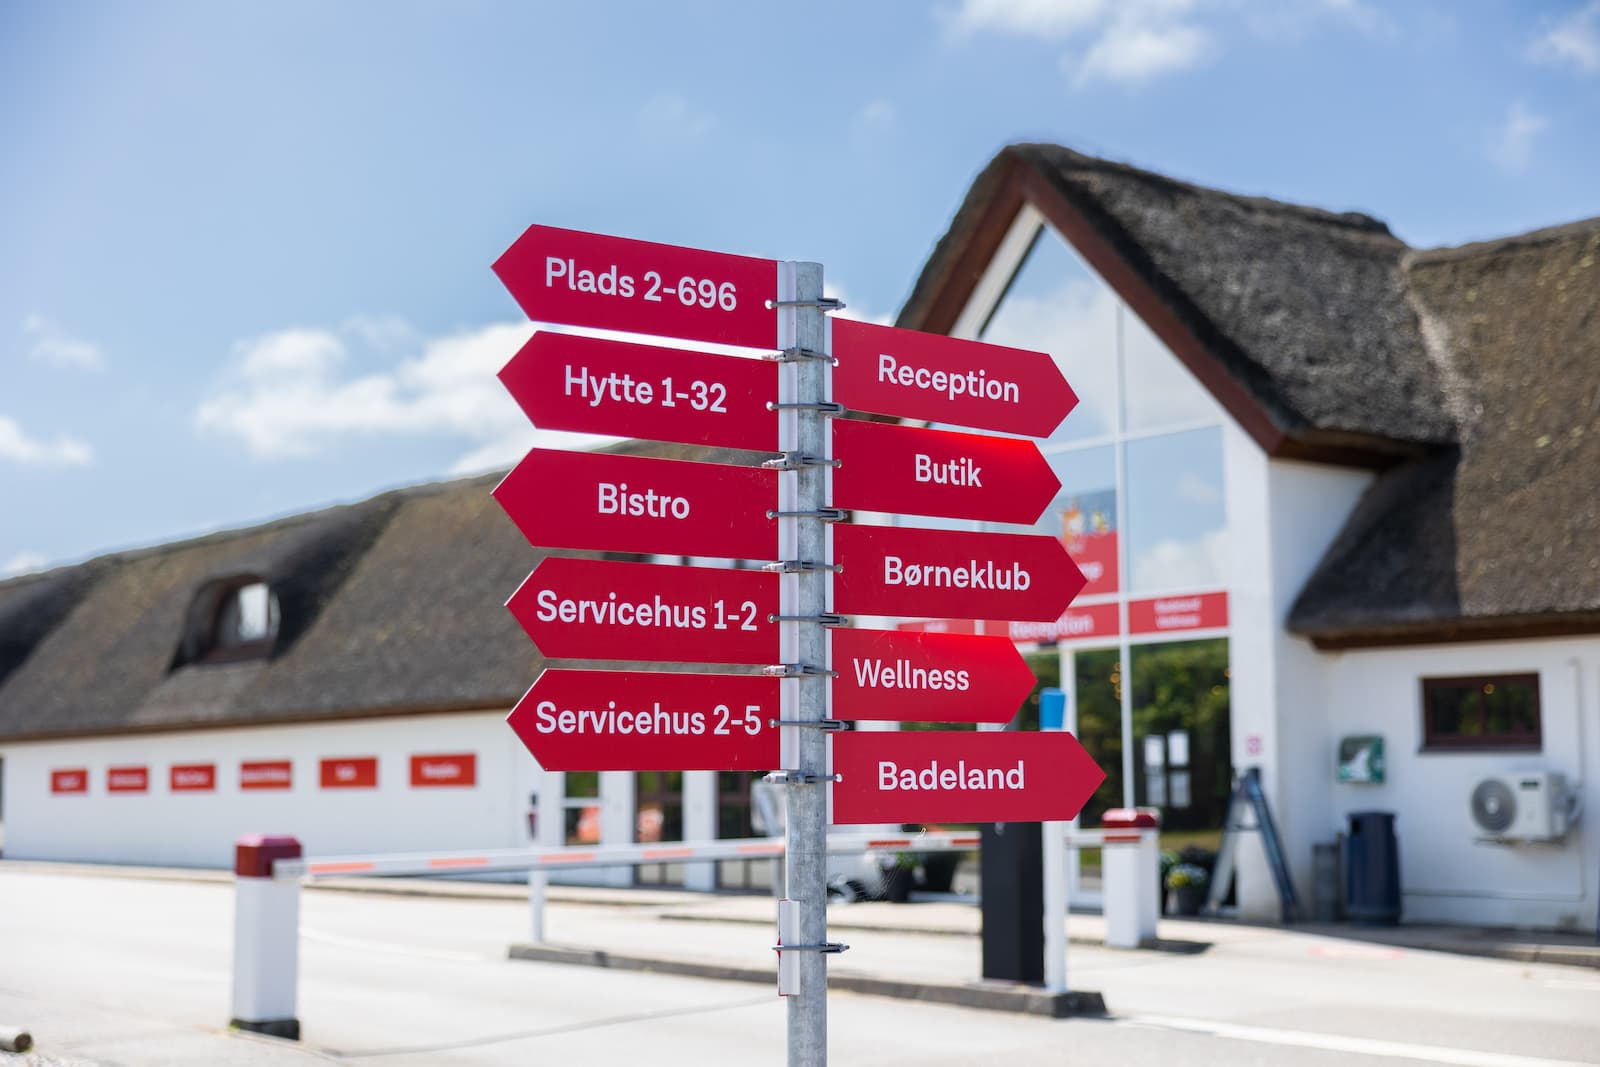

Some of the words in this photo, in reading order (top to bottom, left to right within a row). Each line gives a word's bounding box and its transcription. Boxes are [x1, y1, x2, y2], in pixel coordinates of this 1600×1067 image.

[546, 256, 635, 298] Plads
[643, 271, 737, 312] 2-696
[565, 364, 653, 407] Hytte
[661, 377, 727, 413] 1-32
[878, 353, 1019, 403] Reception
[914, 452, 982, 489] Butik
[597, 482, 690, 521] Bistro
[884, 556, 1030, 592] Børneklub
[536, 589, 706, 629] Servicehus
[714, 599, 758, 632] 1-2
[853, 658, 970, 692] Wellness
[535, 700, 706, 736] Servicehus
[713, 703, 762, 736] 2-5
[878, 760, 1025, 792] Badeland
